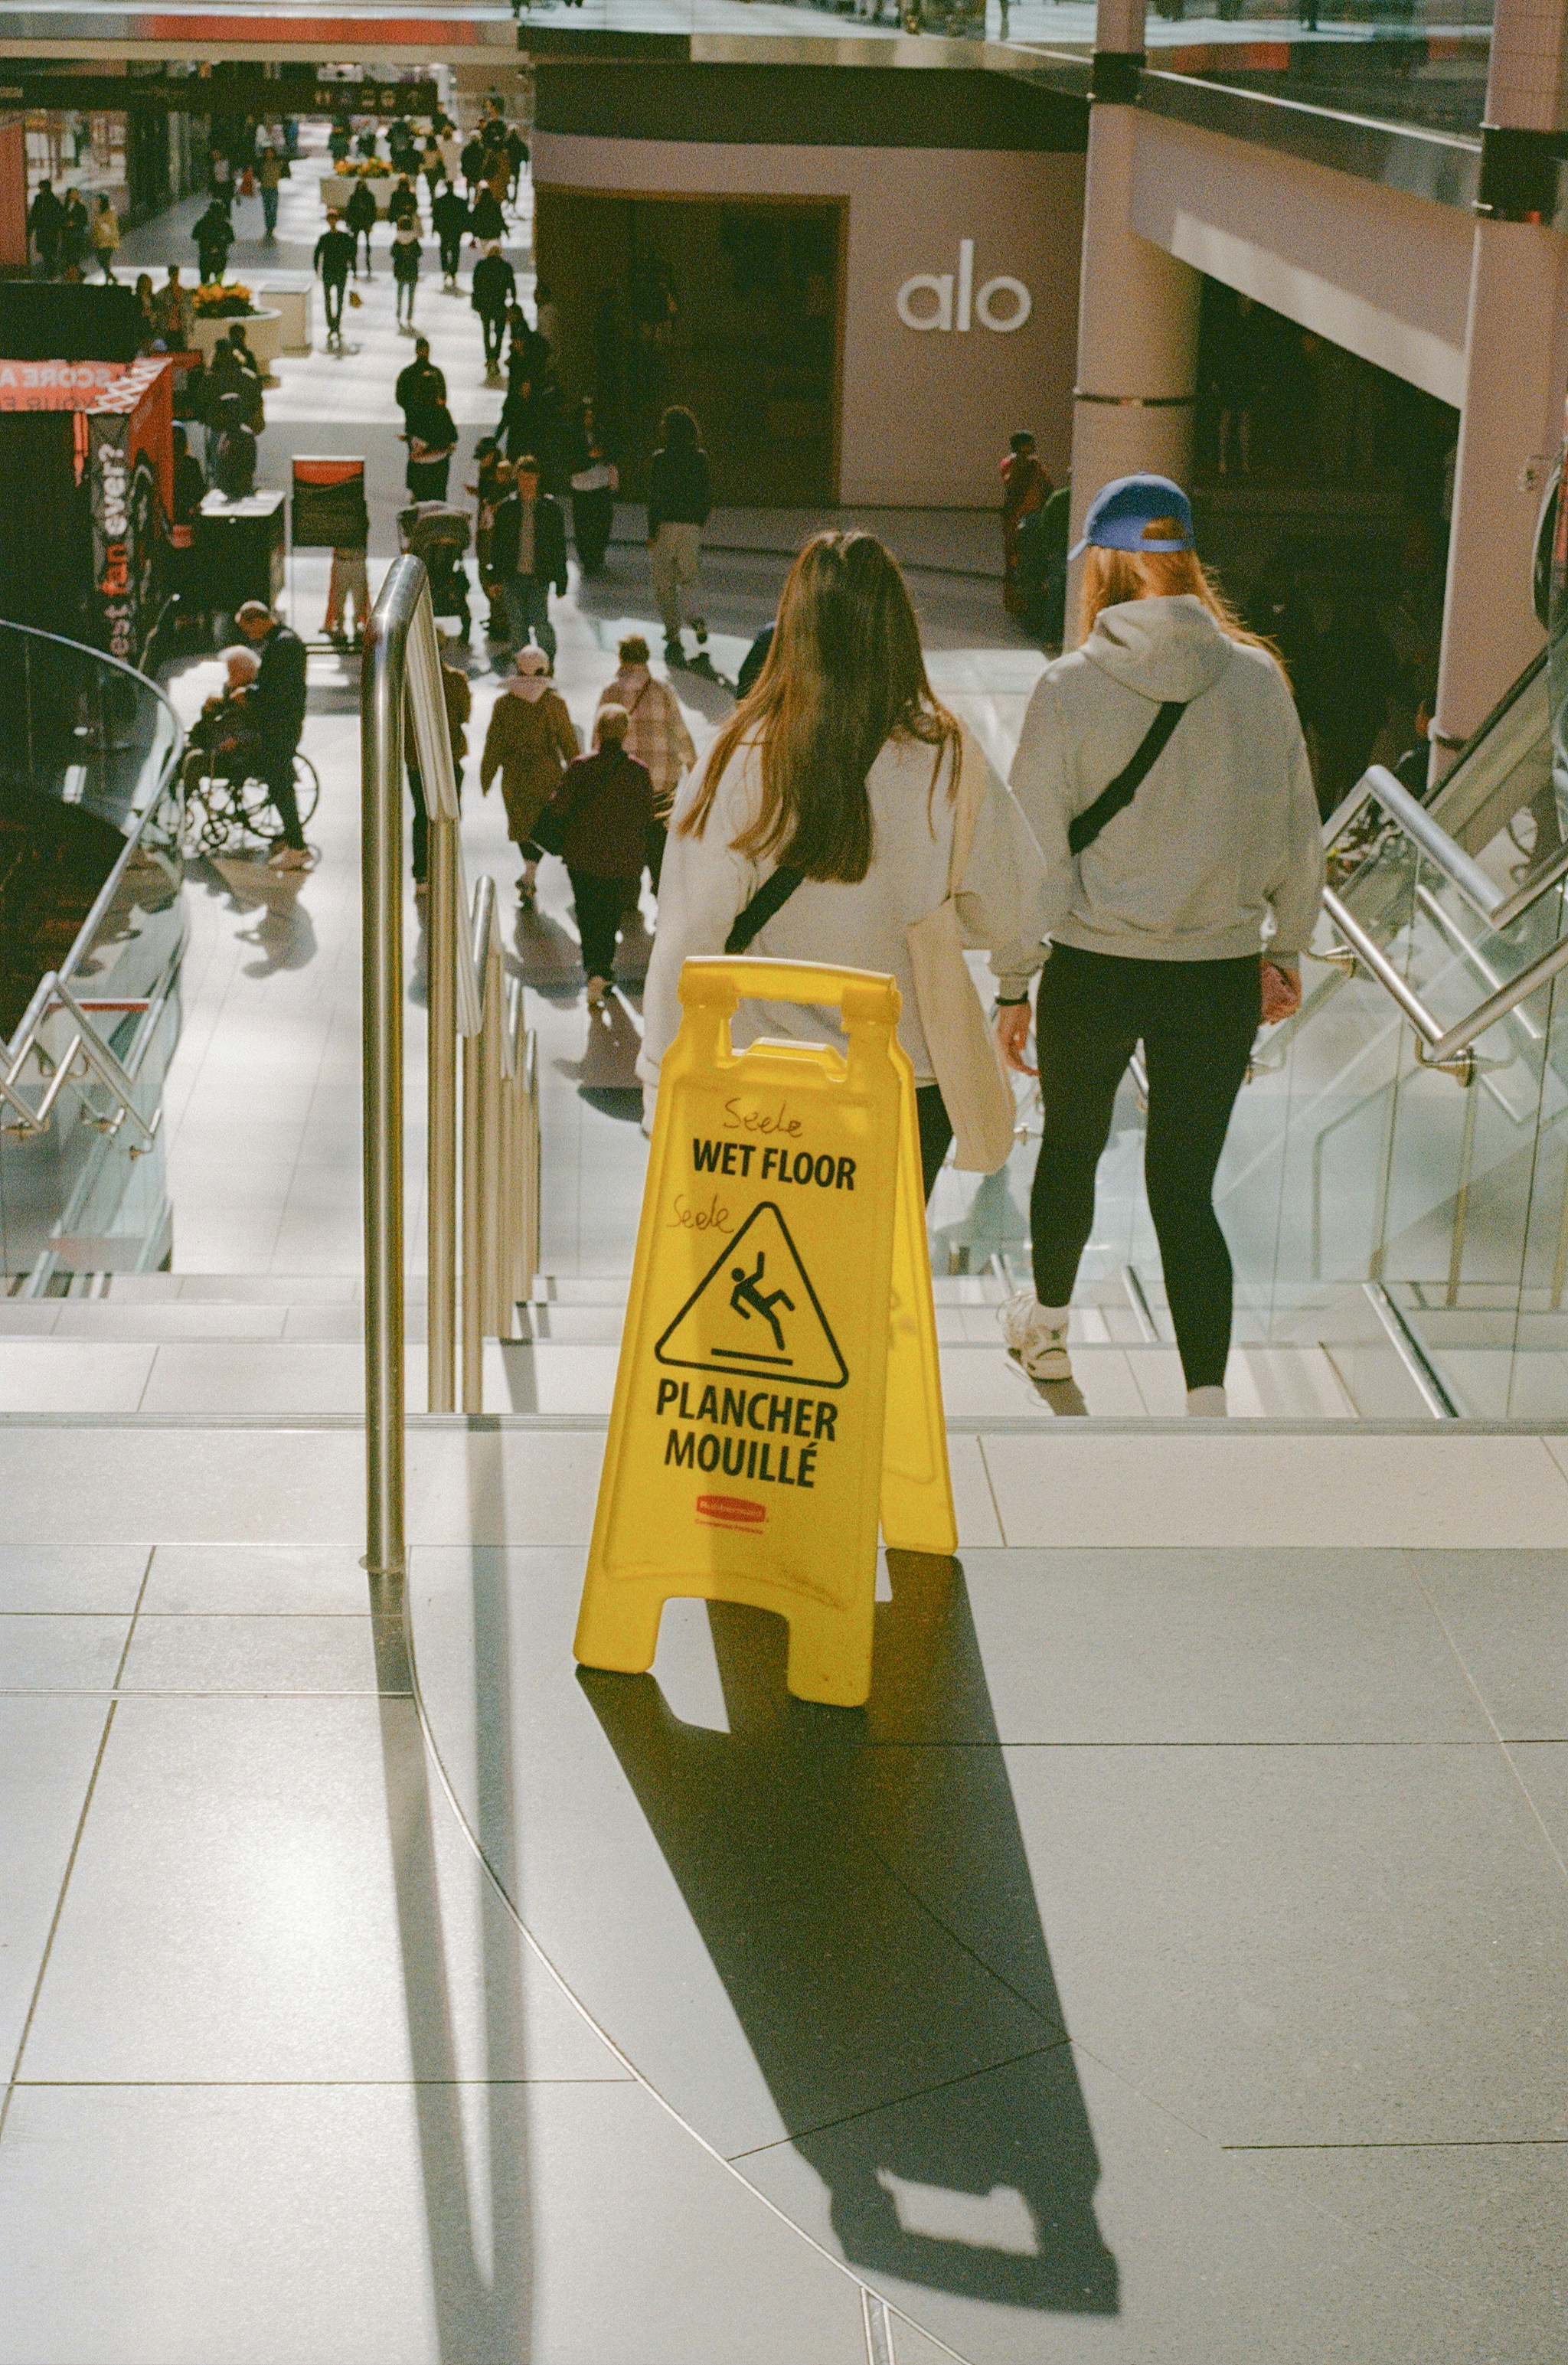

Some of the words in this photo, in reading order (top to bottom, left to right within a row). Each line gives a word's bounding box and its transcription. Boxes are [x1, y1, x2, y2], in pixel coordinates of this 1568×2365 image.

[895, 238, 1032, 332] alo
[98, 443, 128, 536] ever?
[100, 543, 129, 596] fan
[105, 603, 130, 668] est
[692, 1138, 757, 1178] WET
[760, 1147, 858, 1191] FLOOR
[655, 1378, 839, 1442] PLANCHER
[664, 1429, 818, 1489] MOUILLÉ
